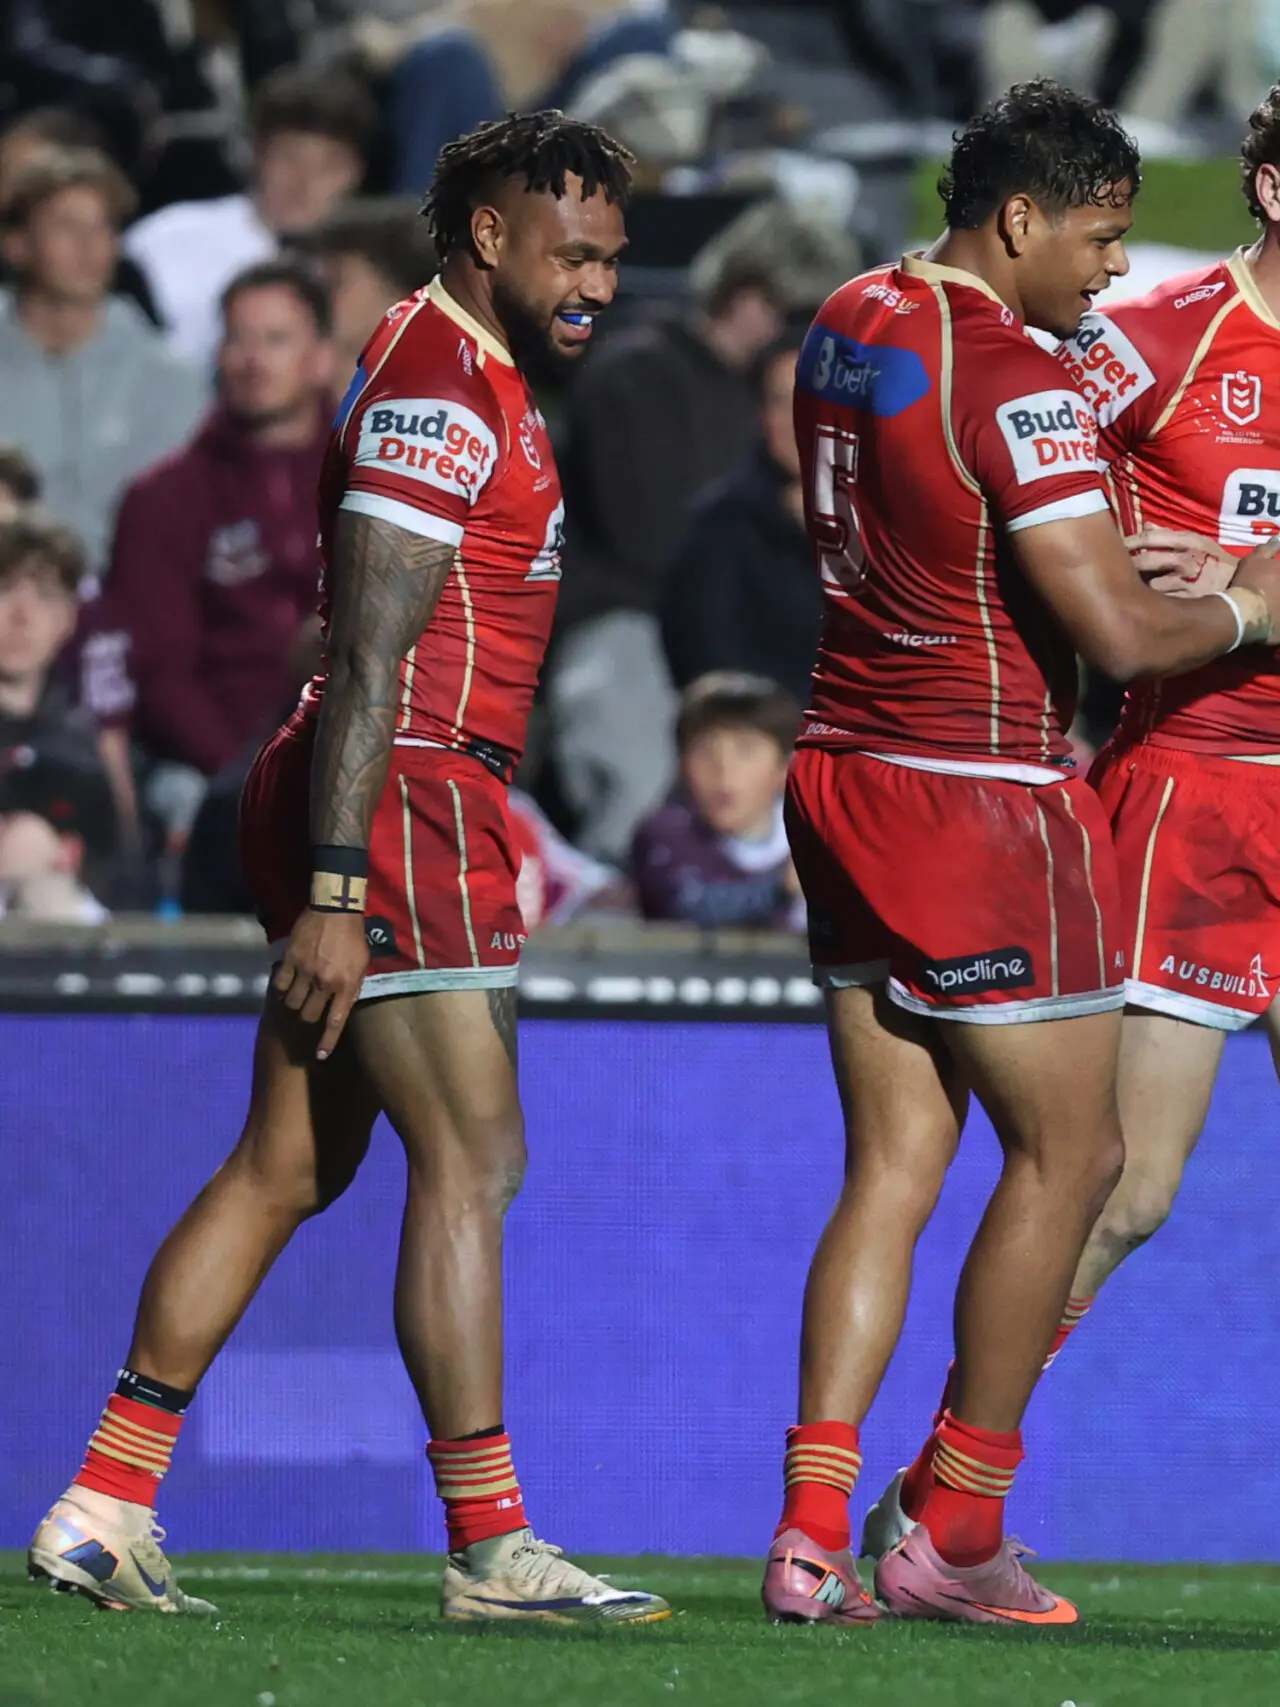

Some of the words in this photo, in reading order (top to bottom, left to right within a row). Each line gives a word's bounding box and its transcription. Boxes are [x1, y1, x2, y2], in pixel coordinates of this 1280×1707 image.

[1076, 327, 1139, 397] dget
[370, 408, 490, 473] Budget
[813, 423, 869, 598] 5
[1159, 955, 1256, 997] AUSBUILD
